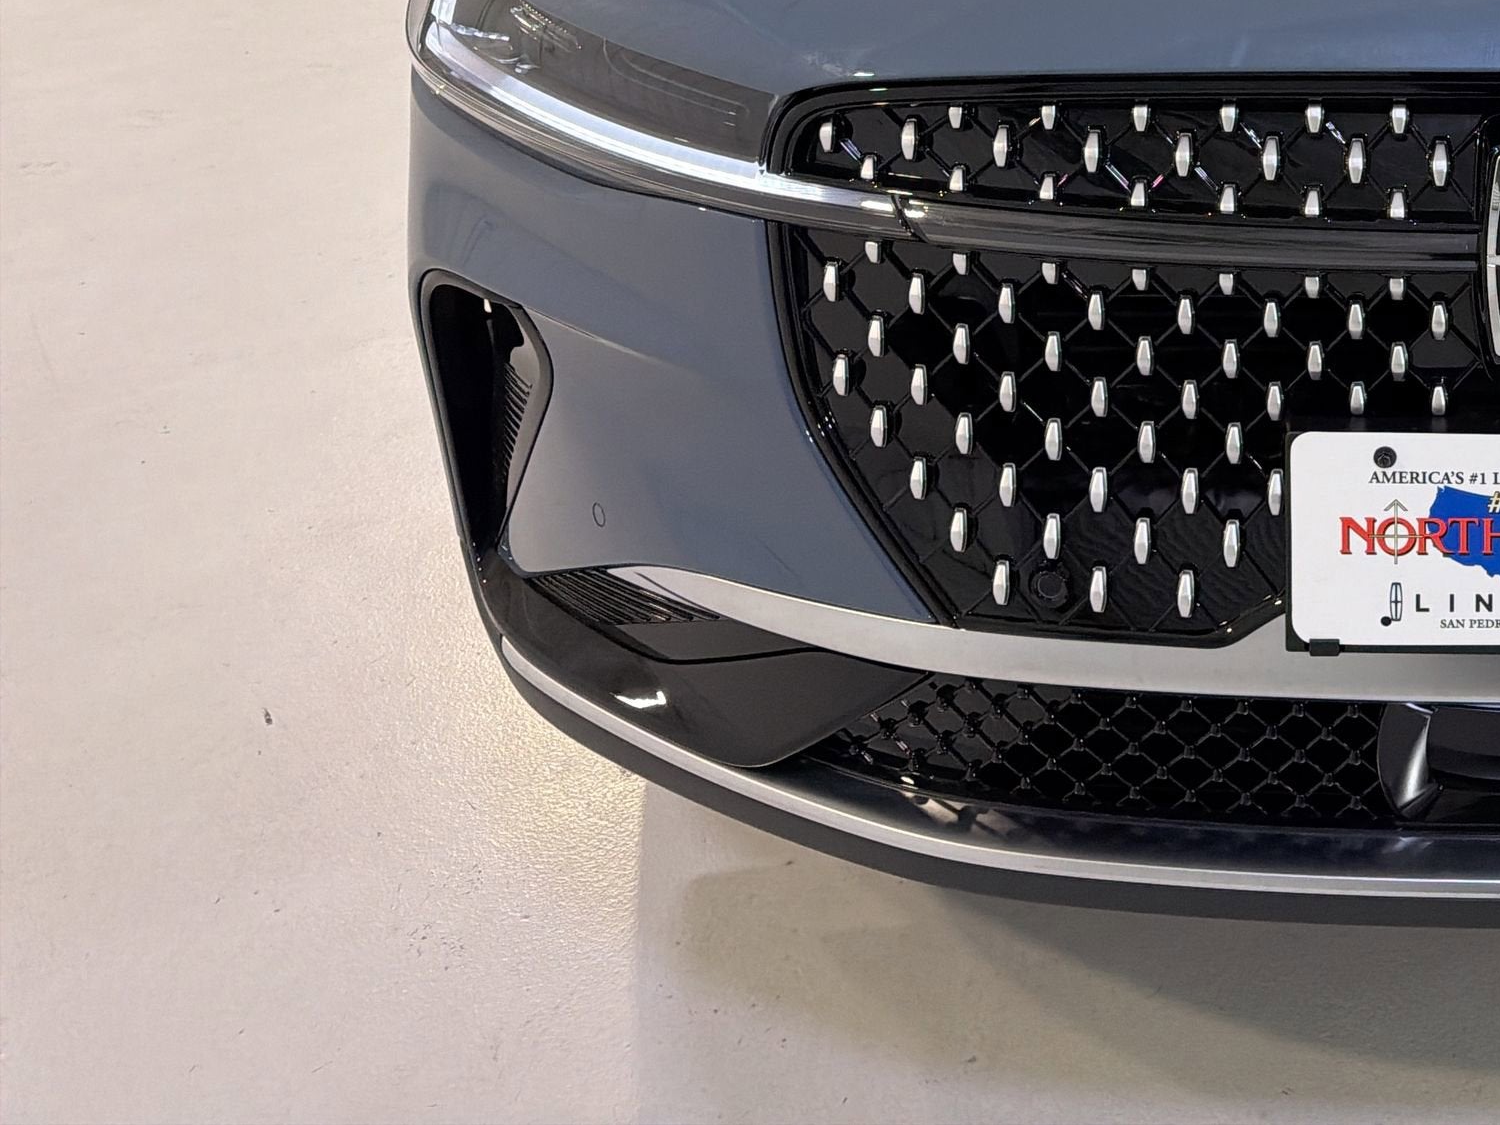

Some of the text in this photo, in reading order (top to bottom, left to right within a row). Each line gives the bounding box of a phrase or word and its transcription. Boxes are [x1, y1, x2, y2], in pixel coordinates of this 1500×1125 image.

[1368, 471, 1464, 485] AMERICA'S
[1469, 472, 1486, 485] #1
[1440, 619, 1465, 629] SAN
